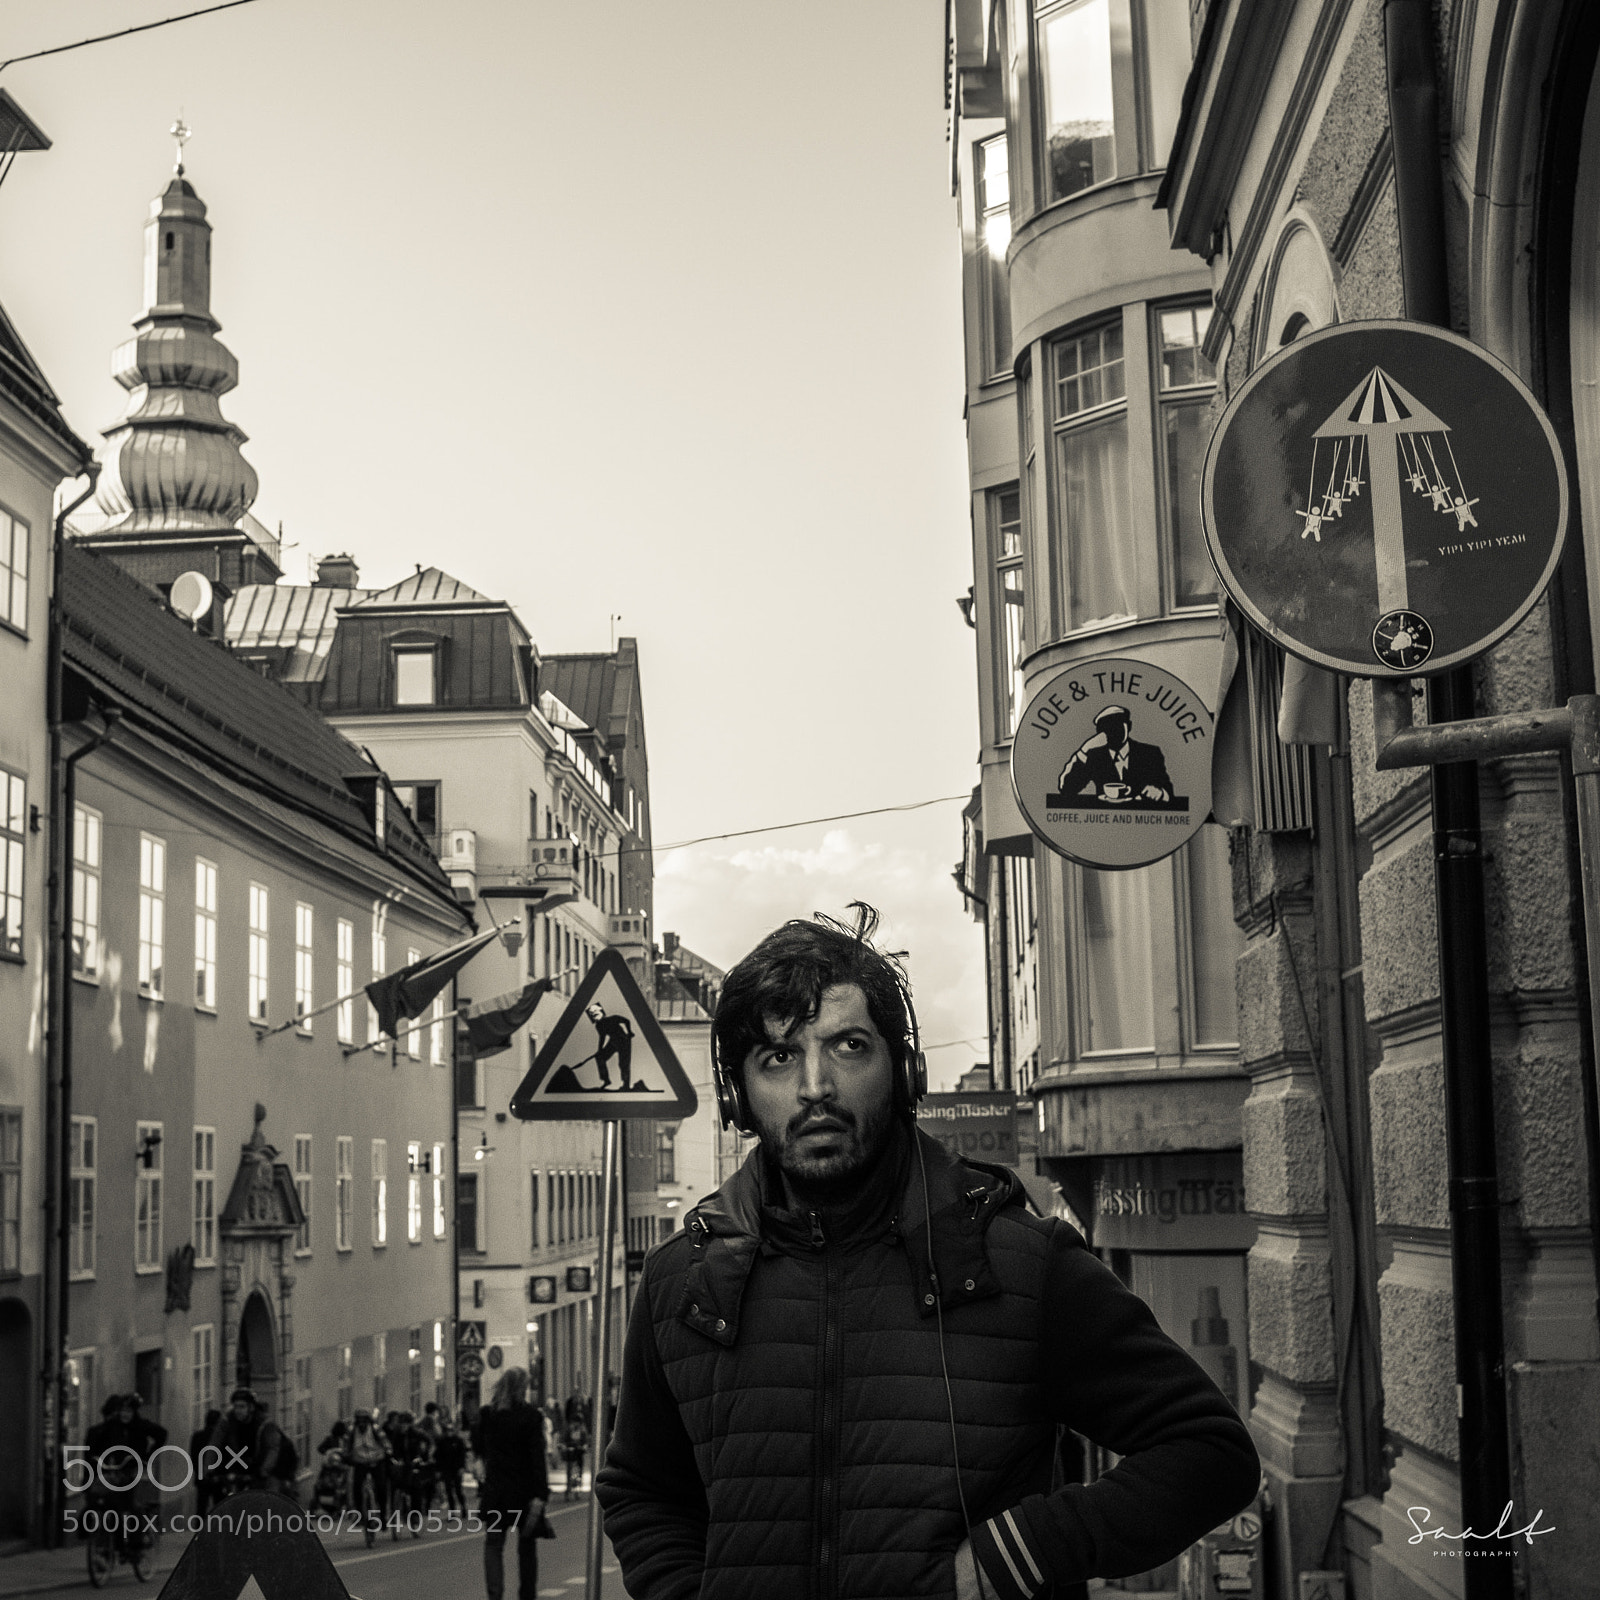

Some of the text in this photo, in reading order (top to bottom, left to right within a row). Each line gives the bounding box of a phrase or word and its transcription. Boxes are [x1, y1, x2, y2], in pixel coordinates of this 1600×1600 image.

[1438, 534, 1526, 556] YIPI YIPI YEAH
[1031, 671, 1206, 744] JOE & THE JUICE
[1046, 812, 1191, 826] COFFEE, JUICE AND MUCH MORE
